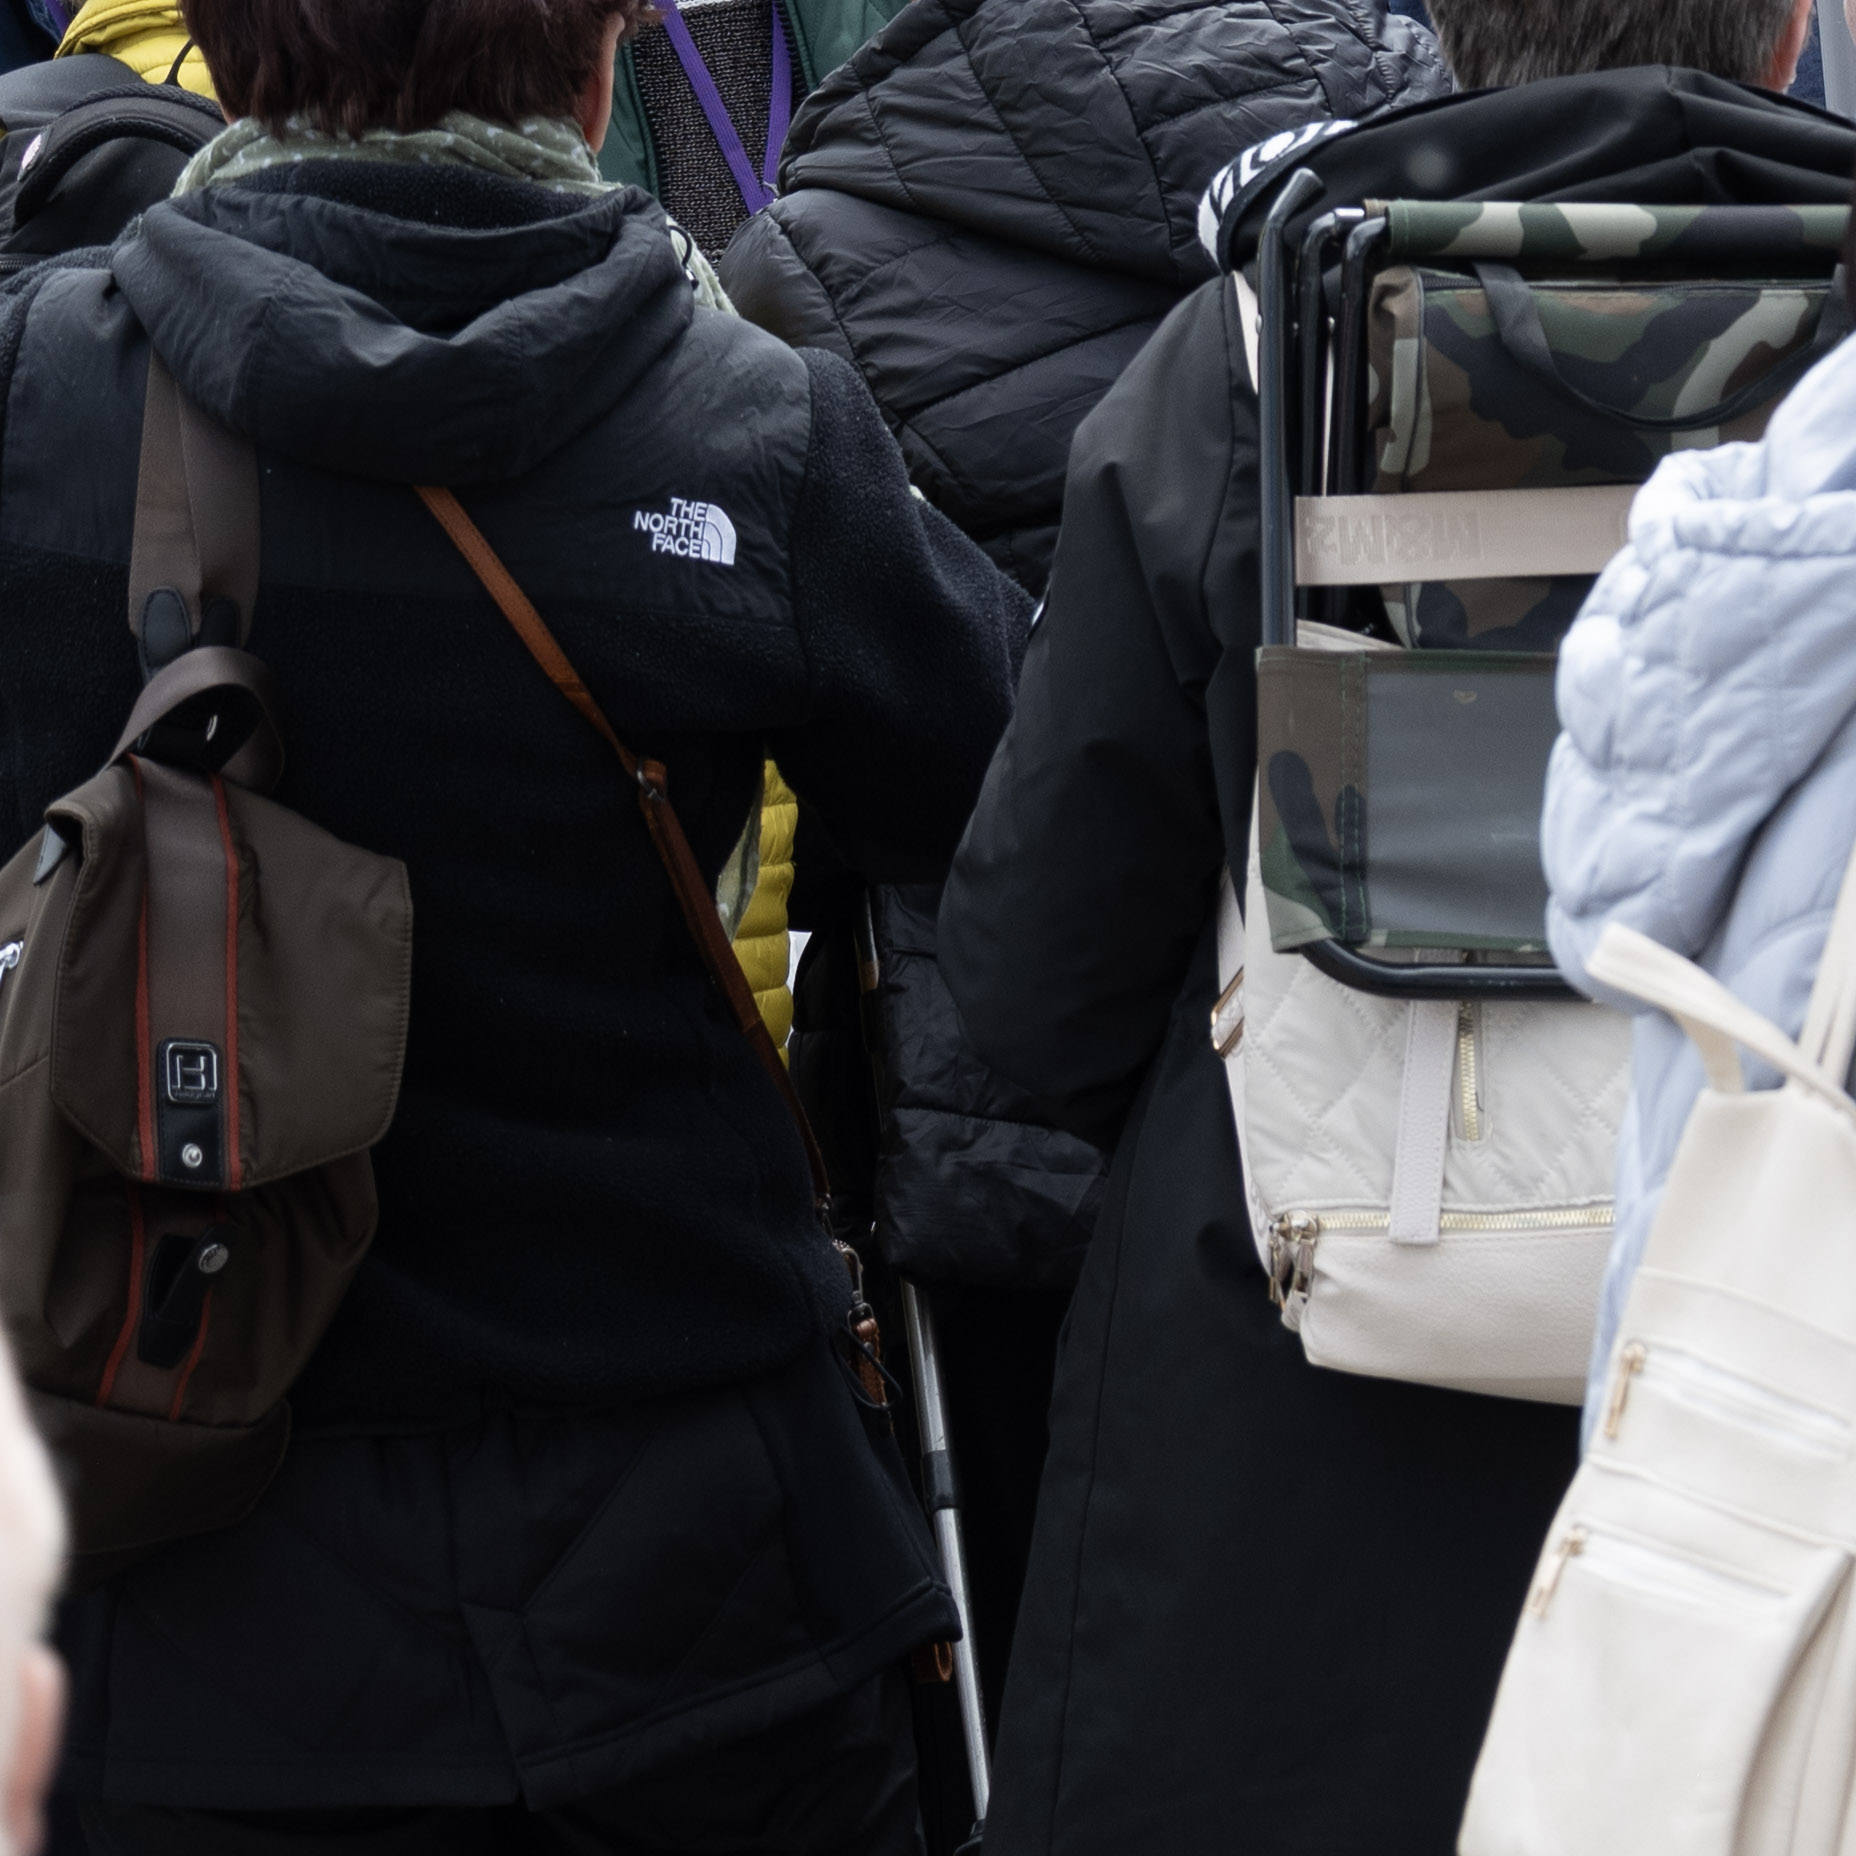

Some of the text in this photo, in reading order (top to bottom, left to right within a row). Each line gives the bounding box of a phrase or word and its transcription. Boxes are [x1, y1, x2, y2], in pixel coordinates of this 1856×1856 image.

[671, 497, 708, 521] THE
[633, 510, 704, 540] NORTH
[652, 533, 702, 559] FACE
